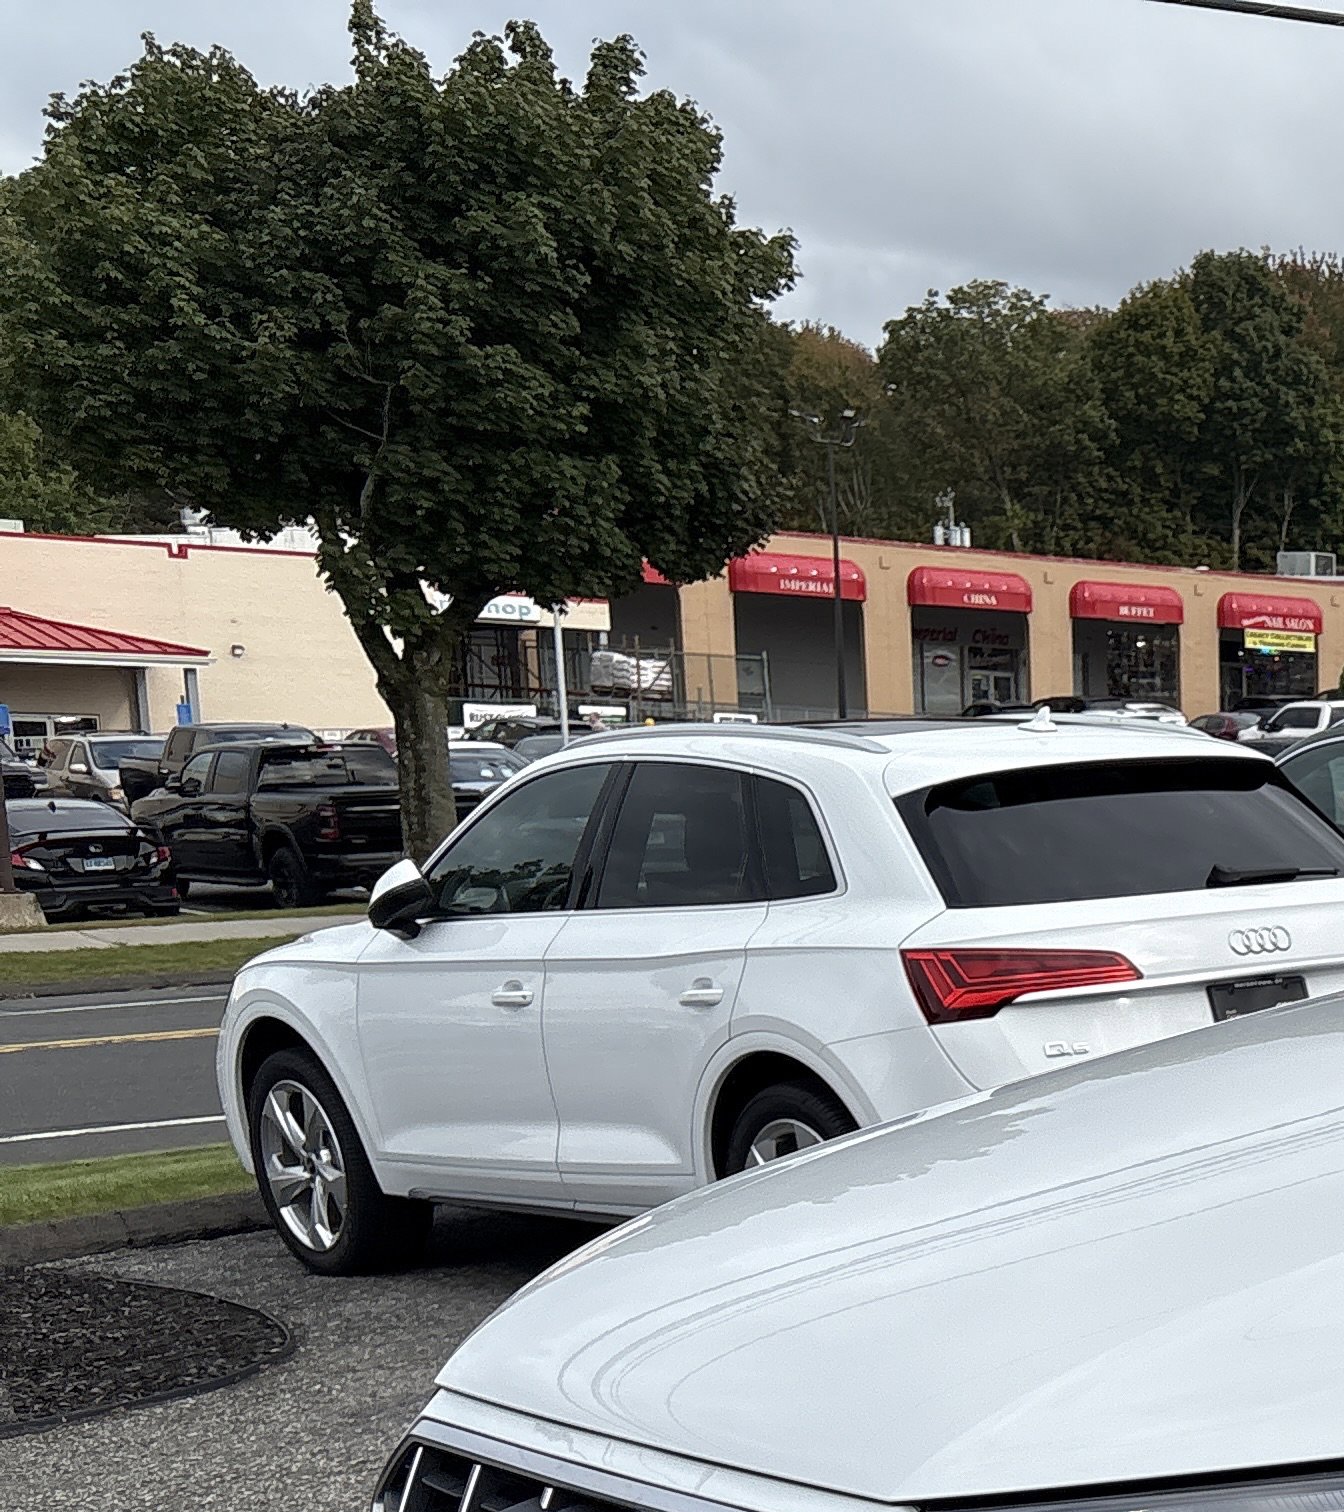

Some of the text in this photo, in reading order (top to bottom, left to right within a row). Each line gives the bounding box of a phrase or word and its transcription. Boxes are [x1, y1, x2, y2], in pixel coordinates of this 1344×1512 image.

[780, 579, 834, 593] IMPERIAL
[963, 594, 998, 605] CHINA
[1043, 1040, 1090, 1059] Q5
